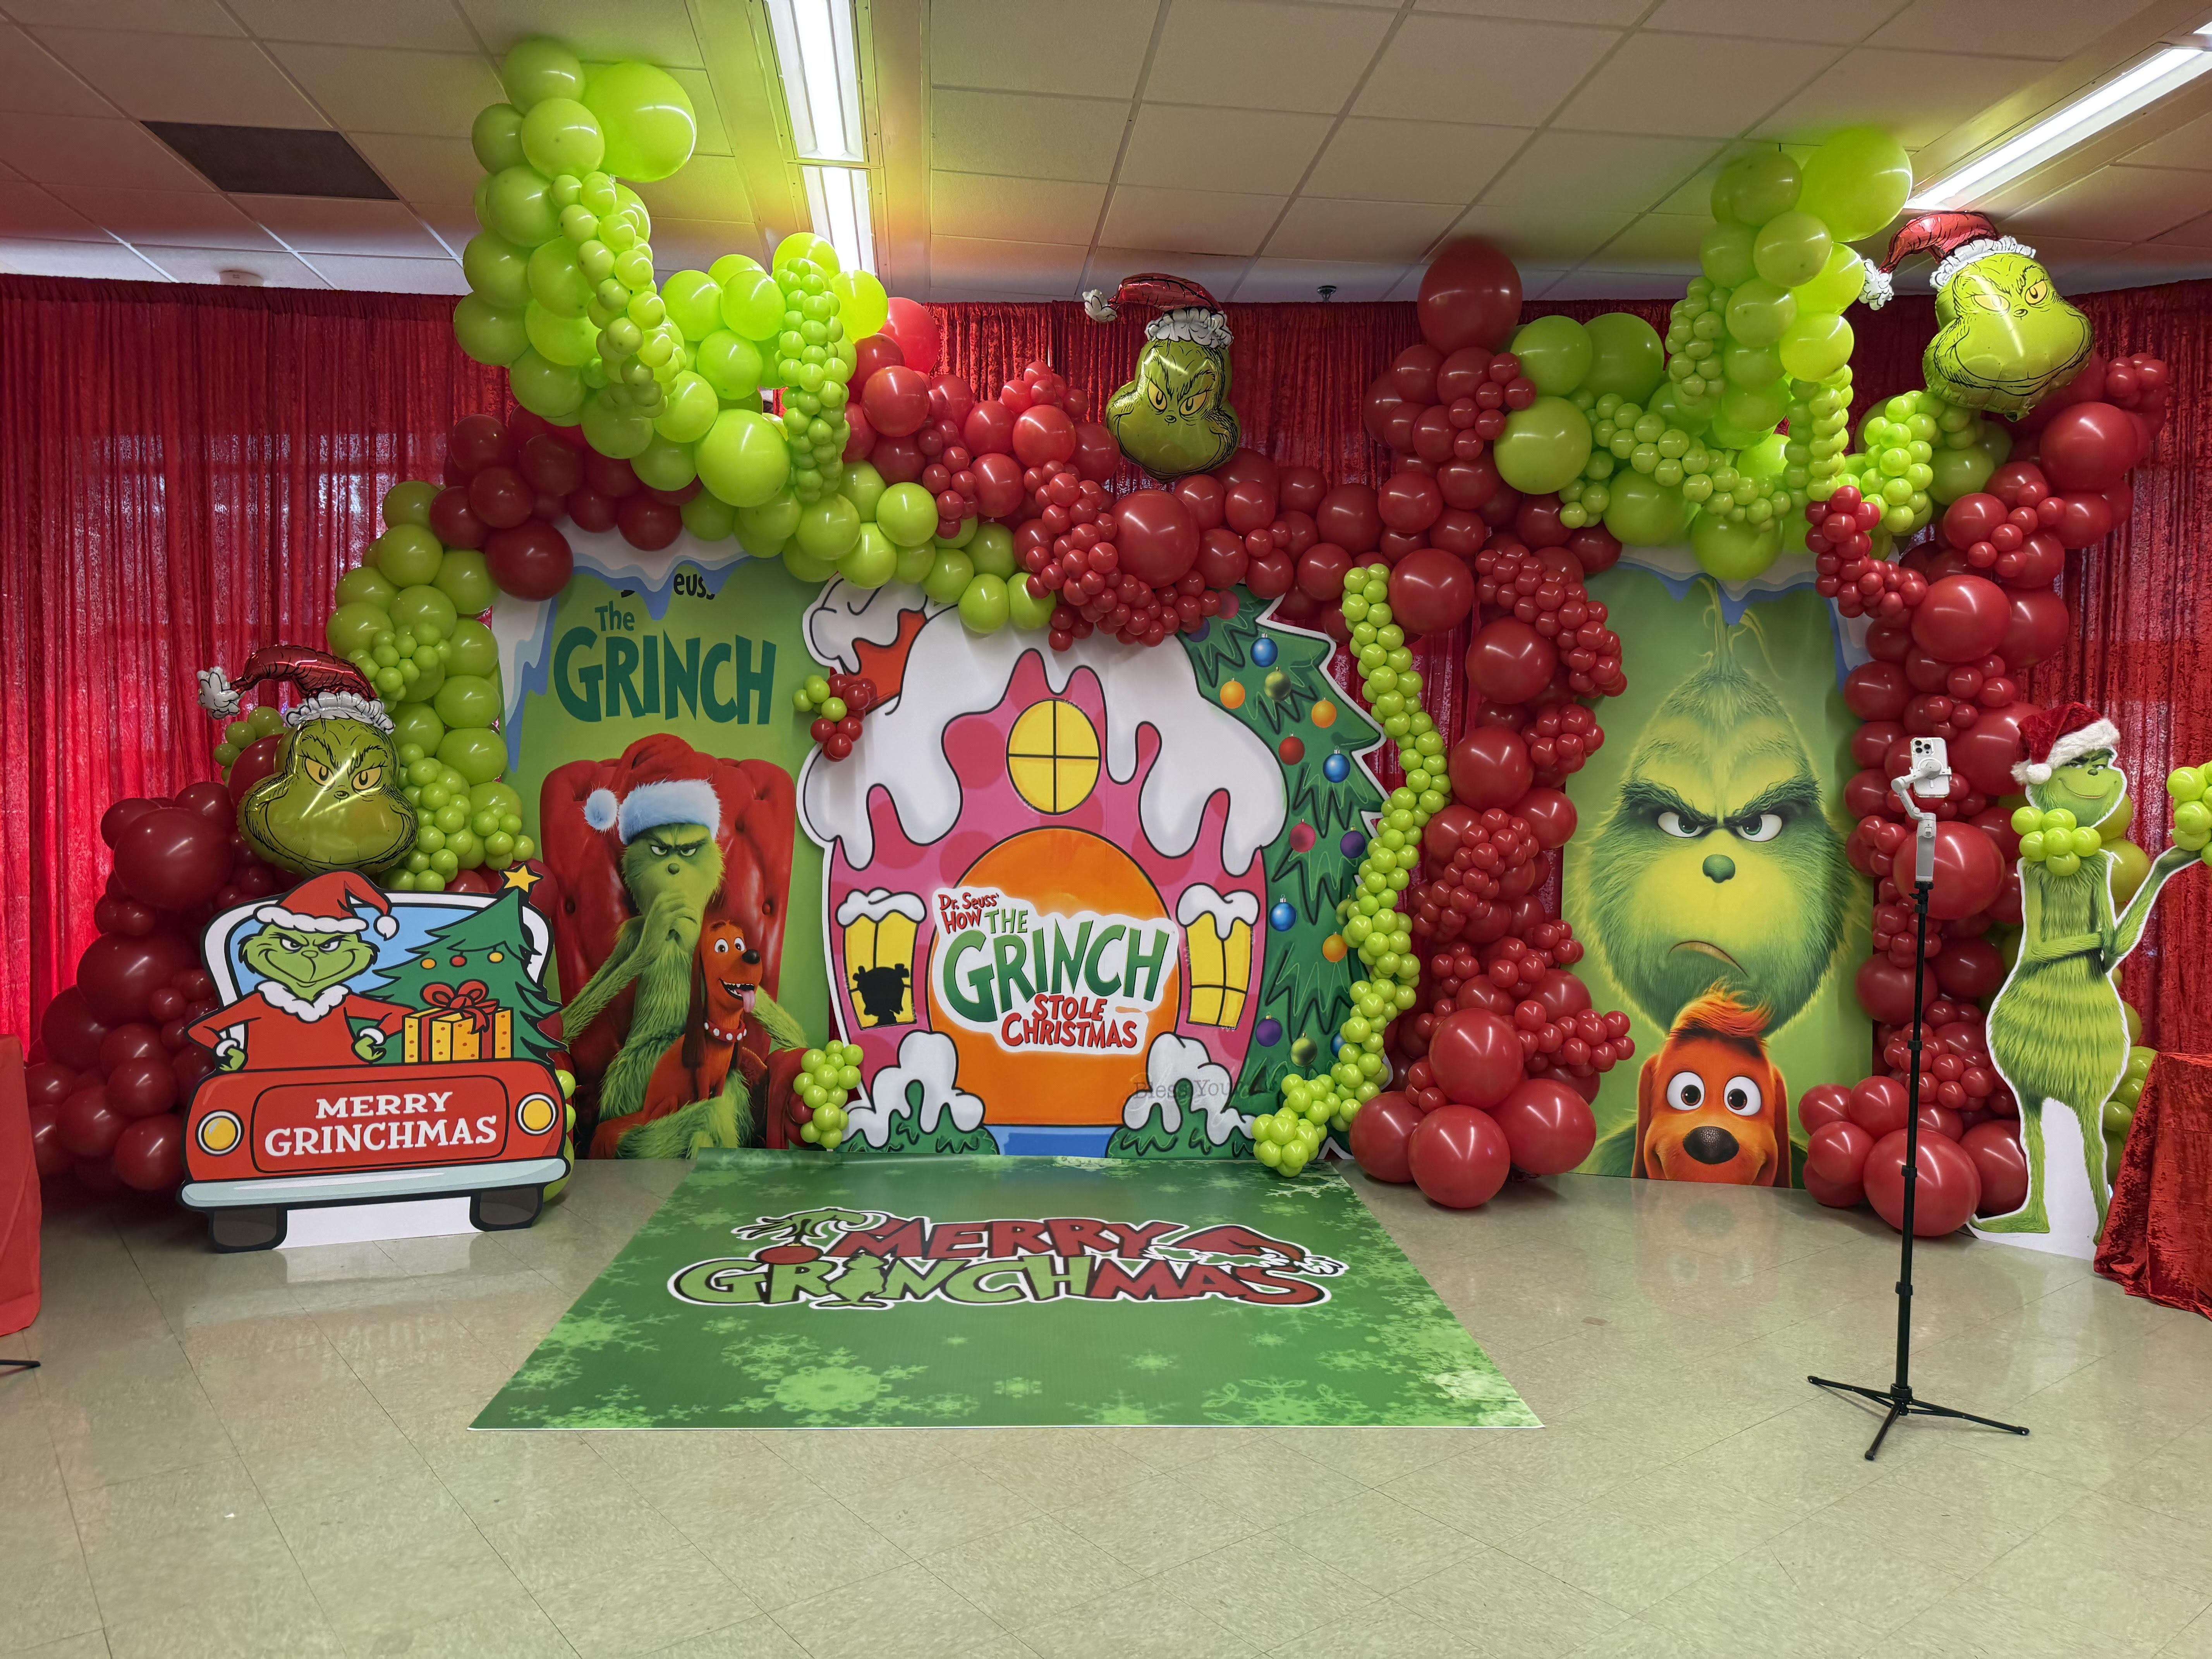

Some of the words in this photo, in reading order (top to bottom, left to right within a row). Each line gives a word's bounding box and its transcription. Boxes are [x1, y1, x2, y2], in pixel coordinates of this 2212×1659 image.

[673, 573, 715, 600] eus
[595, 601, 635, 631] The
[554, 626, 776, 725] GRINCH
[938, 894, 959, 910] Dr.
[941, 909, 982, 934] HOW
[984, 908, 1028, 934] THE
[943, 918, 1170, 1022] GRINCH
[1032, 994, 1108, 1021] STOLE
[1001, 1012, 1137, 1048] CHRISTMAS
[316, 1092, 453, 1119] MERRY
[264, 1115, 497, 1157] GRINCHMAS
[829, 1217, 1185, 1260] MERRY
